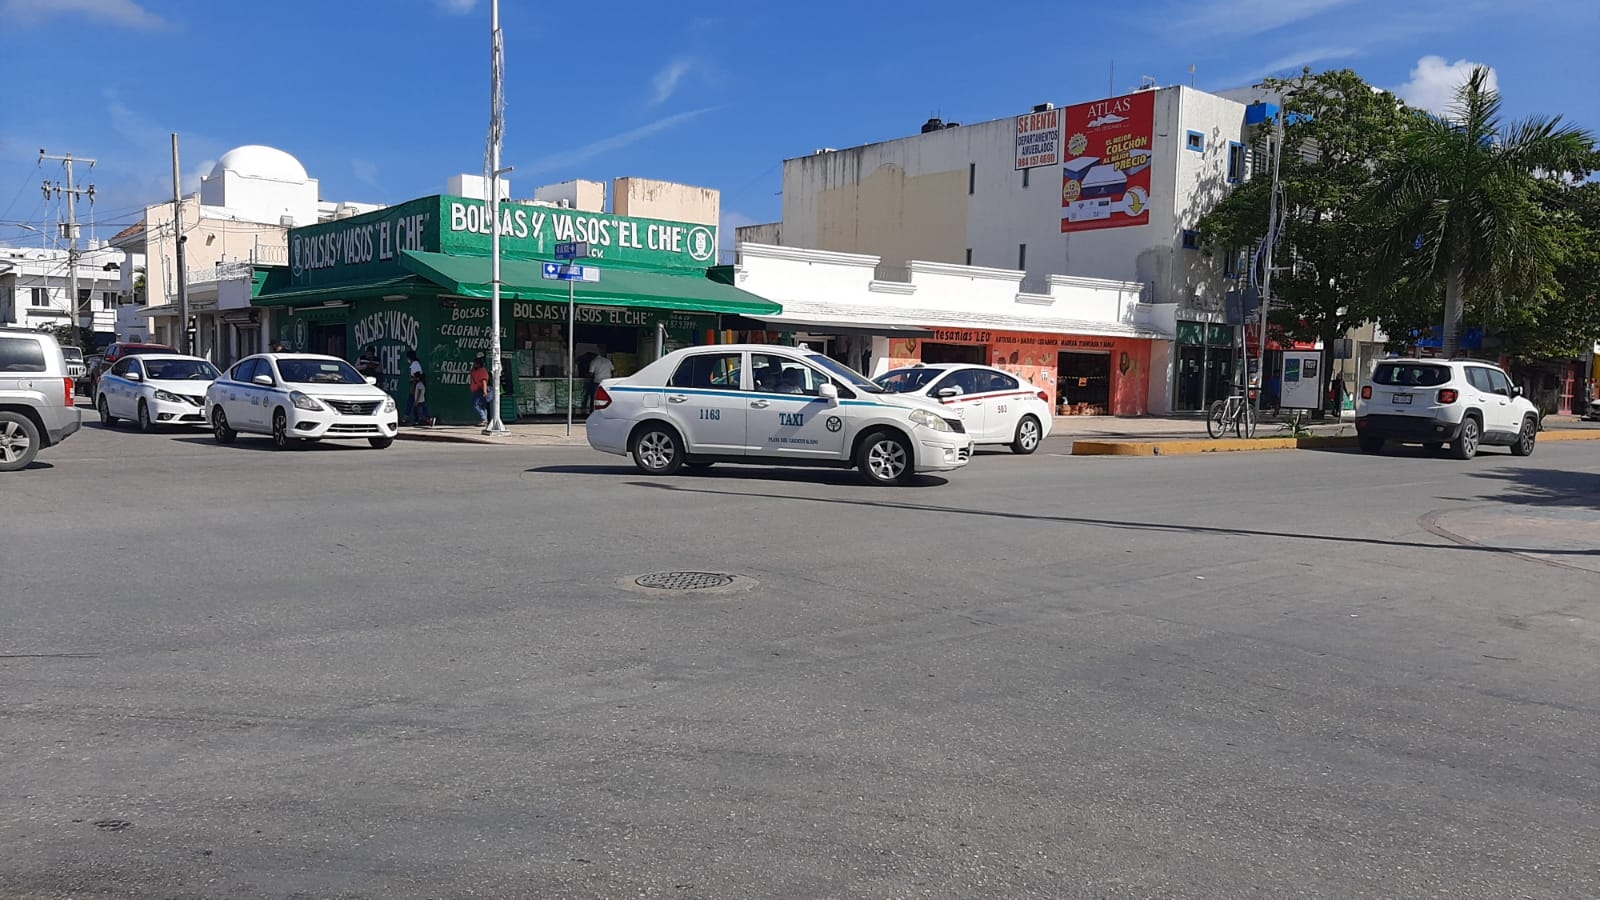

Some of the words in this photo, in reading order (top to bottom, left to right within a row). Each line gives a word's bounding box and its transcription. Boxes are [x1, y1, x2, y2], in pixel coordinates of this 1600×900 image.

[1087, 98, 1131, 118] ATLAS
[1018, 117, 1029, 134] SE
[1030, 111, 1057, 131] RENTA
[1018, 130, 1058, 146] DEPARTAMENTOS
[1106, 136, 1148, 155] COLCHÓN
[1022, 141, 1054, 155] AMUEBLADOS
[1114, 155, 1147, 171] PRECIO
[552, 213, 611, 246] VASOS
[304, 232, 337, 271] BOLSAS
[343, 225, 374, 265] VASOS
[513, 302, 556, 319] BOLSAS
[574, 307, 602, 323] ASOS
[354, 311, 385, 351] BOLSAS
[390, 310, 420, 351] VASOS
[700, 409, 720, 420] 1163
[779, 413, 804, 427] TAXI
